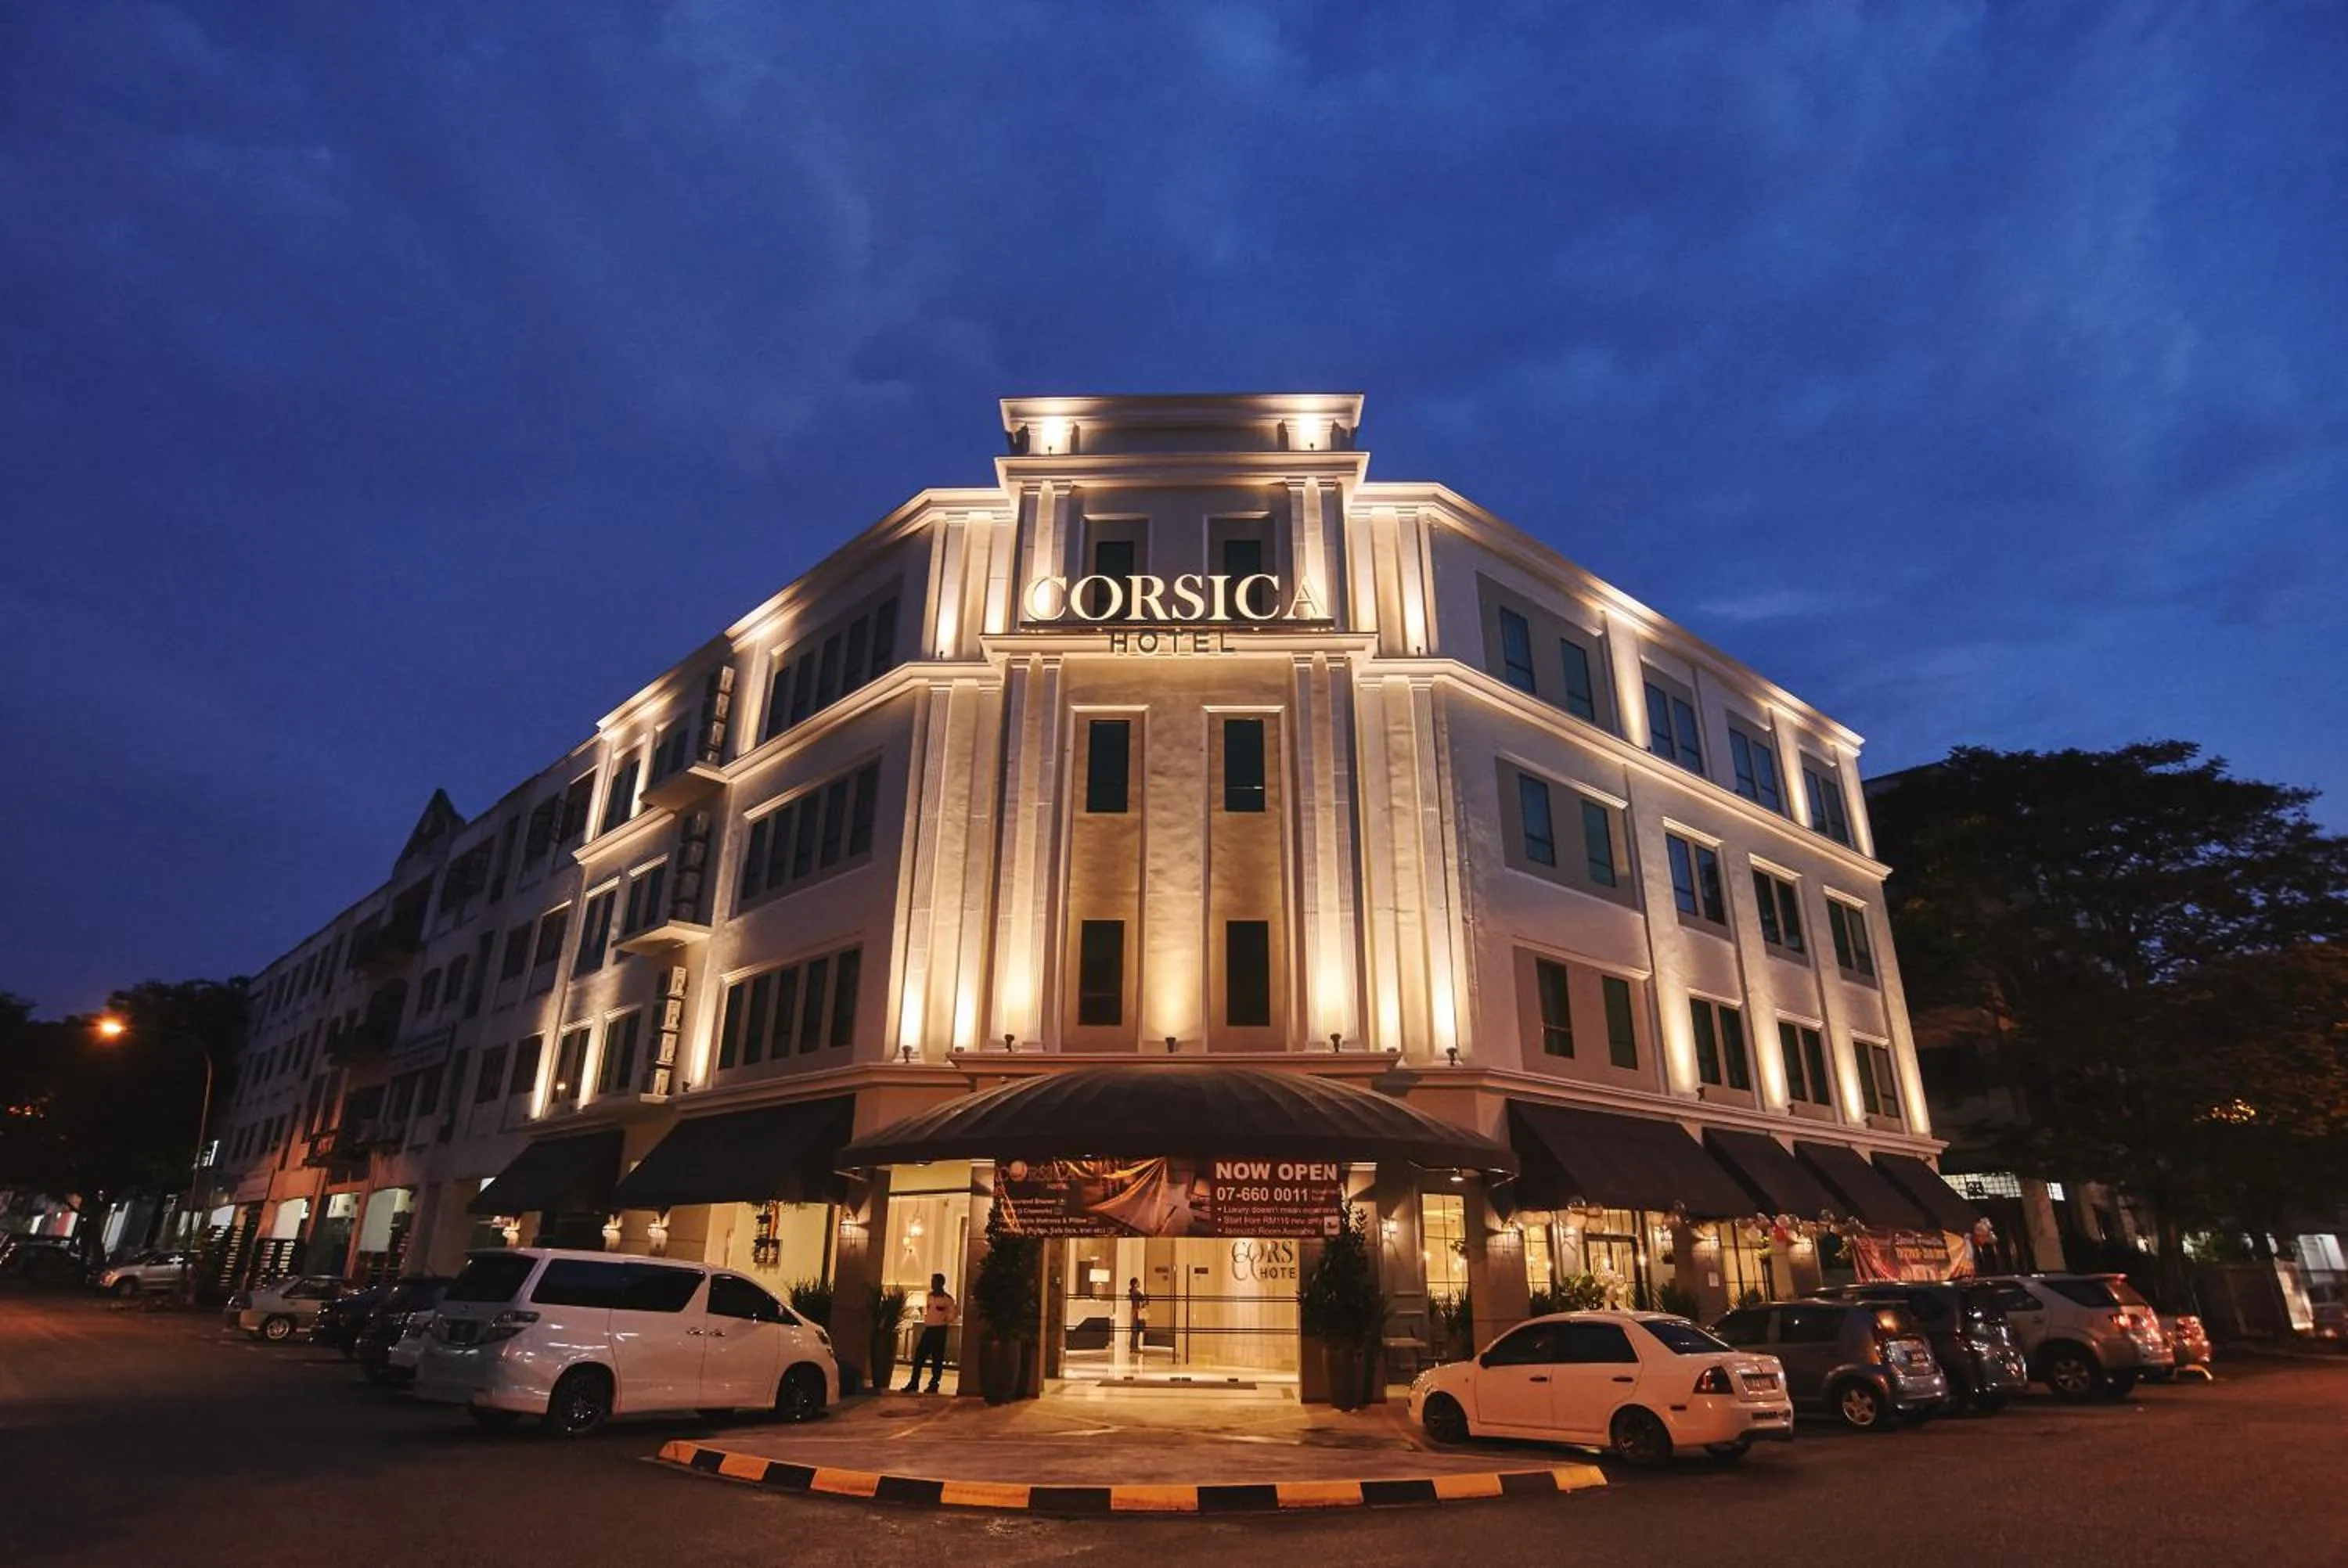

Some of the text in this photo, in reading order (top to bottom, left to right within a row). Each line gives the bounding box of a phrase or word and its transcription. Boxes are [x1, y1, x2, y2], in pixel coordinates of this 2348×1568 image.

[1022, 573, 1331, 621] CORSICA
[1110, 631, 1236, 655] HOTEL
[1215, 1162, 1338, 1181] NOW OPEN
[1216, 1187, 1269, 1202] 07-660
[1273, 1188, 1309, 1203] 0011
[1259, 1267, 1297, 1279] HOTE
